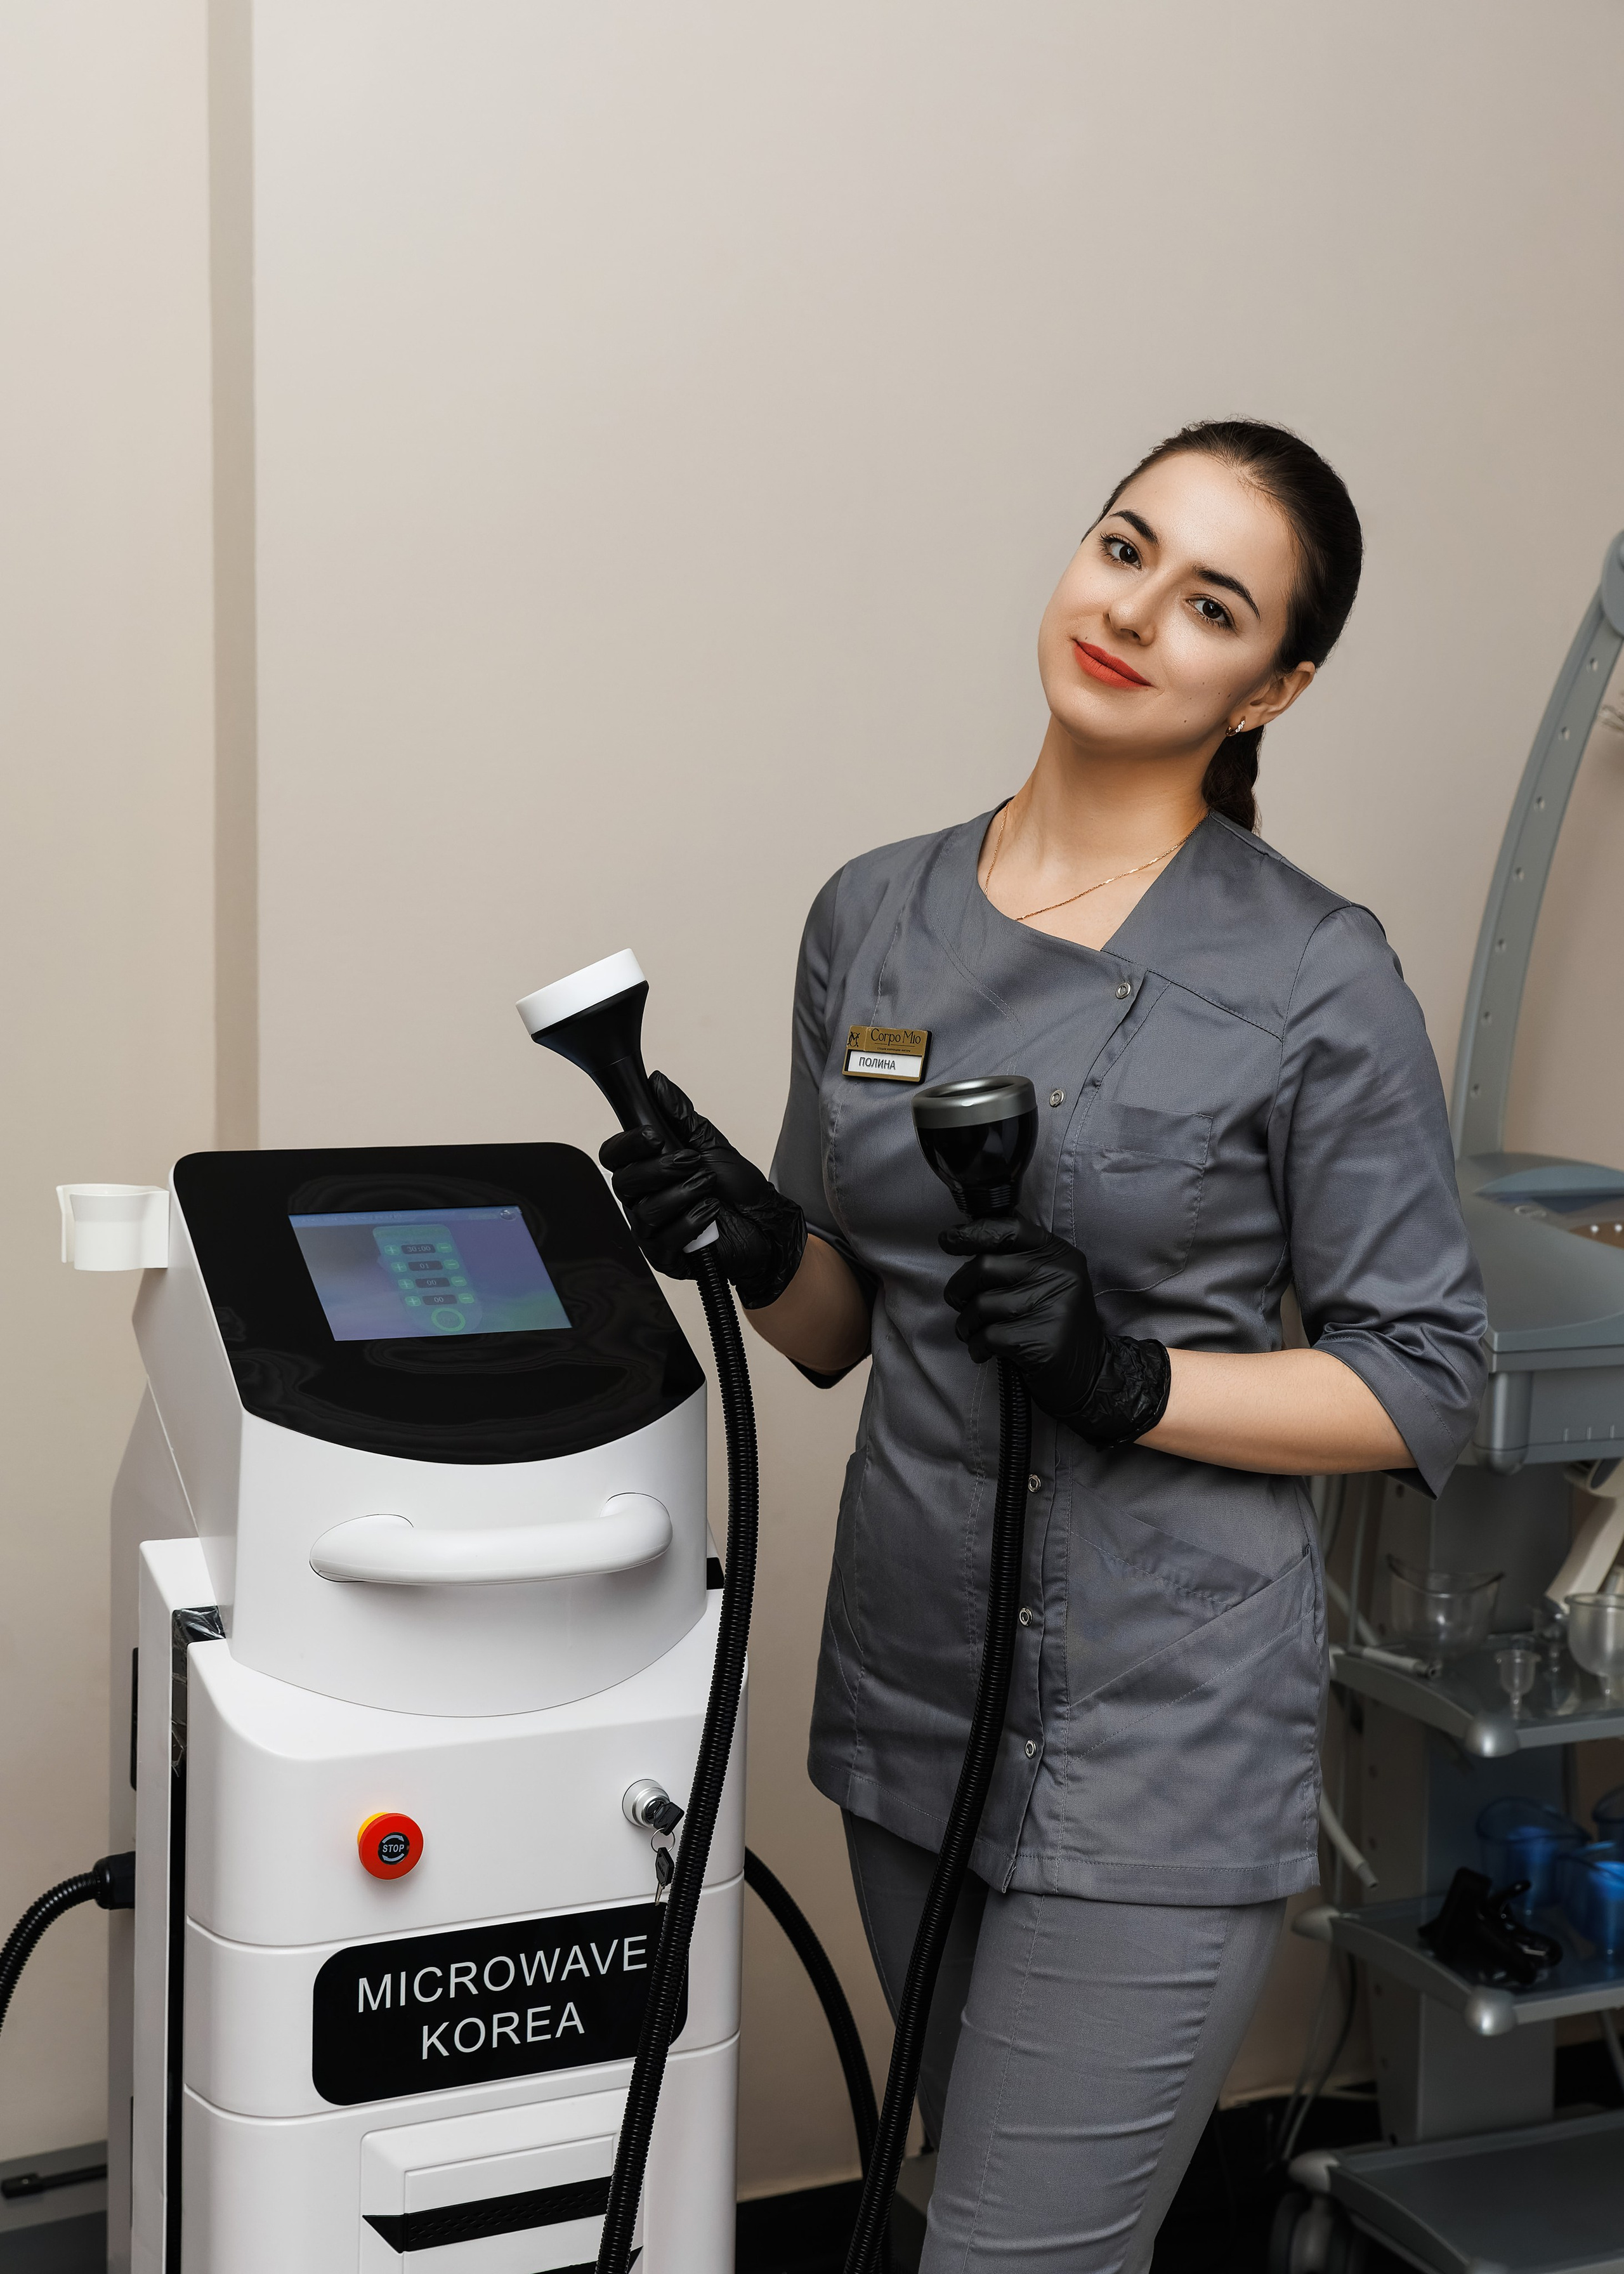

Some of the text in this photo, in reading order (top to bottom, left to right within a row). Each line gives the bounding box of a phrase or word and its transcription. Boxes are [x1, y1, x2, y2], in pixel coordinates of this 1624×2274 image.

[871, 1028, 921, 1046] Corpo Mio
[858, 1056, 896, 1070] ПОЛИНА
[383, 1844, 405, 1853] STOP
[358, 1935, 648, 2013] MICROWAVE
[422, 2002, 586, 2060] KOREA
